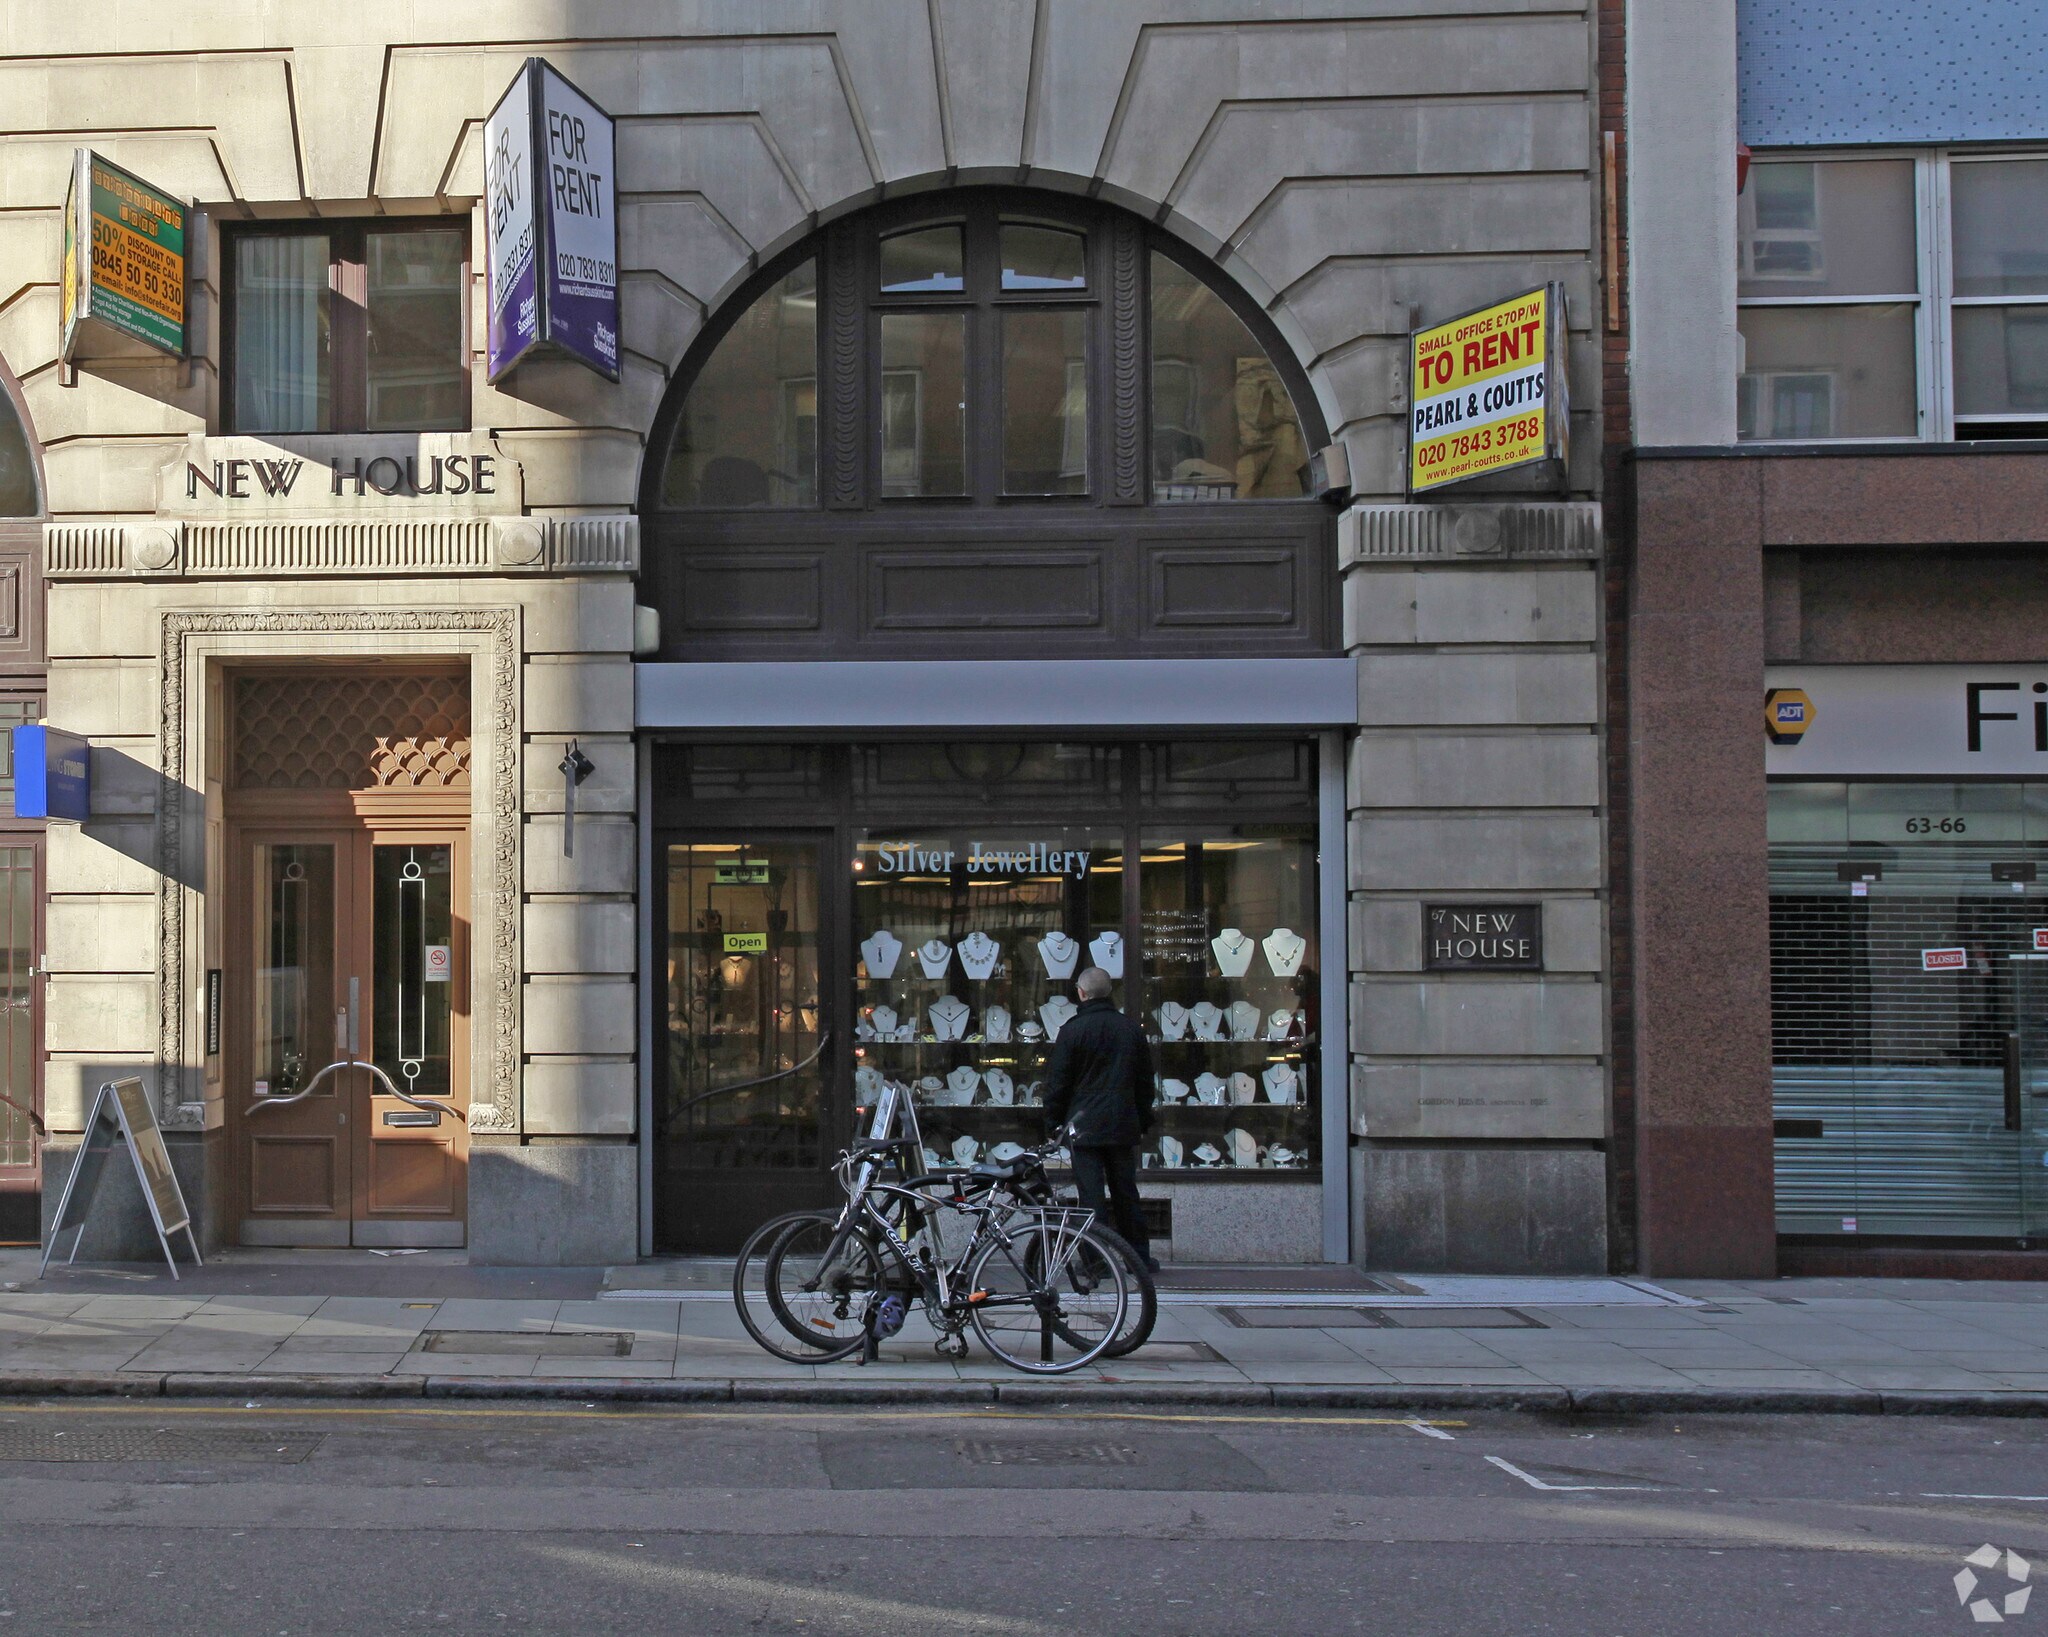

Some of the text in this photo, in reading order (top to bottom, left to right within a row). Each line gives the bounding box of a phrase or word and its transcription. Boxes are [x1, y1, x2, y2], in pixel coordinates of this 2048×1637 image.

[548, 109, 588, 164] FOR
[489, 127, 511, 207] FOR
[491, 152, 521, 254] RENT
[553, 164, 601, 219] RENT
[93, 217, 177, 268] 50% DISCOUNT ON
[504, 243, 519, 280] 7831
[92, 245, 181, 306] 0845 50 50 330
[127, 248, 182, 285] STORAGE CALL:
[558, 253, 615, 283] 020 7831 8311
[92, 270, 181, 320] or email: info@storefair.org
[596, 321, 616, 345] Richard
[1418, 302, 1540, 355] SMALL OFFICE £70P/W
[1418, 320, 1540, 390] TO RENT
[1415, 372, 1544, 433] PEARL & COUTTS
[1418, 416, 1539, 467] 020 7843 3788
[186, 455, 496, 499] NEW HOUSE
[1426, 445, 1530, 480] www.pearl-coutts.co.uk
[1777, 705, 1803, 718] ADT
[1905, 817, 1967, 833] 63-66
[878, 841, 1090, 880] Silver Jewellery
[1432, 909, 1516, 933] 67 NEW
[728, 936, 762, 949] Open
[1435, 938, 1530, 959] HOUSE
[1926, 953, 1963, 965] CLOSED
